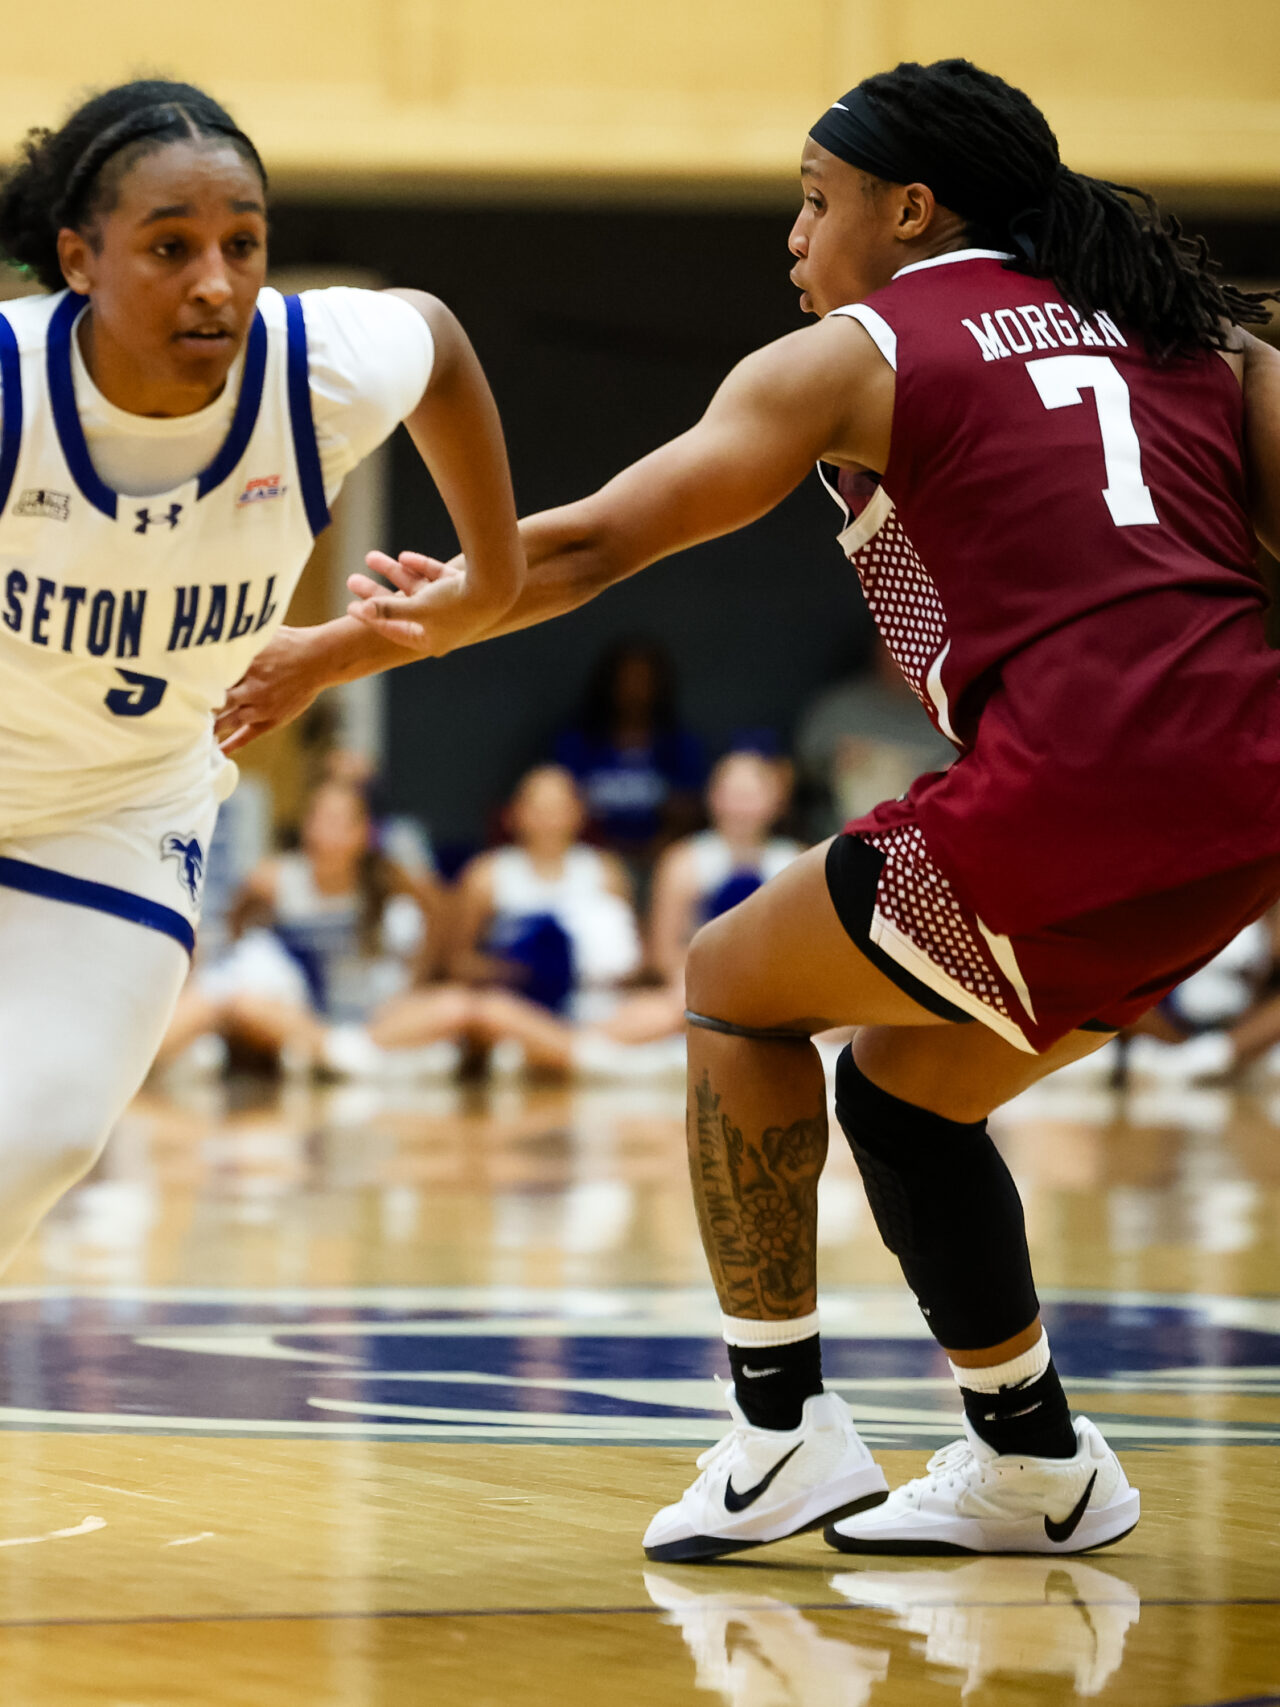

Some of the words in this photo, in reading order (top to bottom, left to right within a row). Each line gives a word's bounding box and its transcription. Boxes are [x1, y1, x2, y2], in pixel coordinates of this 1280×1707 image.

[960, 301, 1129, 363] MORGAN
[1024, 354, 1160, 528] 7
[2, 568, 148, 659] SETON
[166, 573, 278, 653] HALL
